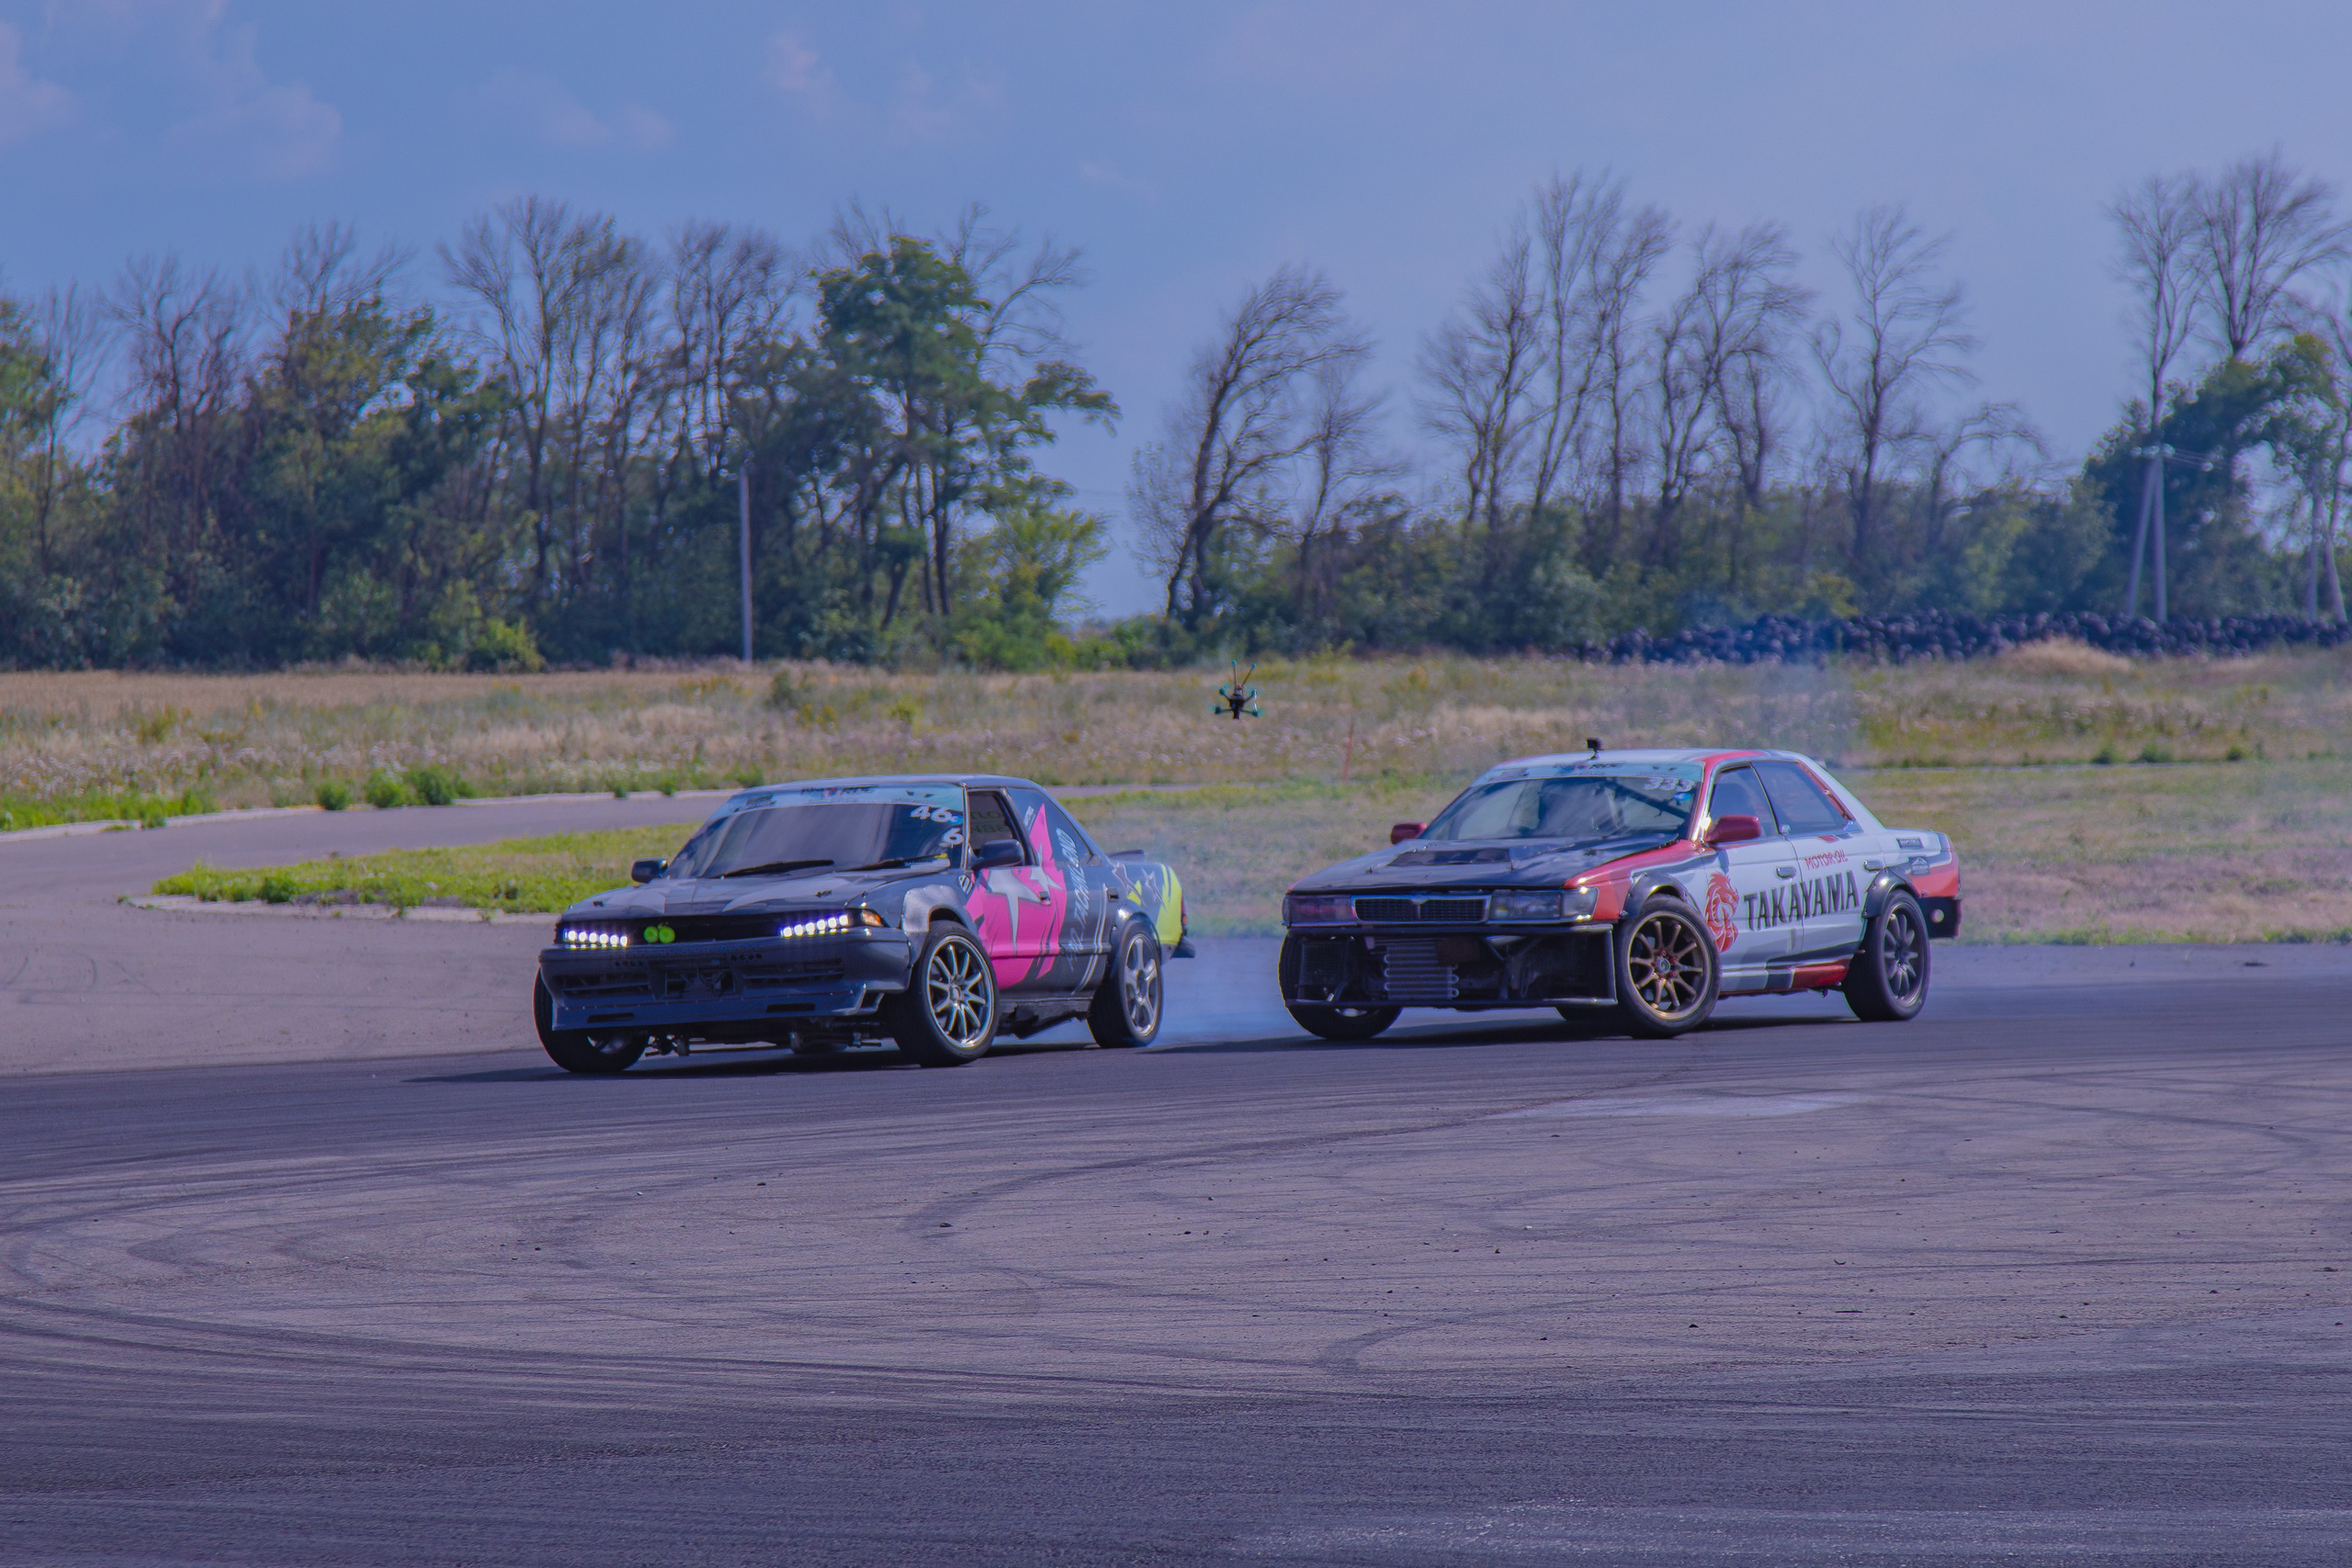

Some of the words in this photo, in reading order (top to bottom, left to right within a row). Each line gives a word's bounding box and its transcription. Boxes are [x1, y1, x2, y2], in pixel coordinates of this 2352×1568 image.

[1643, 776, 1695, 793] 333
[910, 806, 953, 823] 46
[941, 827, 965, 845] 6
[1804, 852, 1836, 871] MOTOR
[1834, 849, 1849, 864] OIL
[1743, 870, 1860, 931] TAKAYAMA
